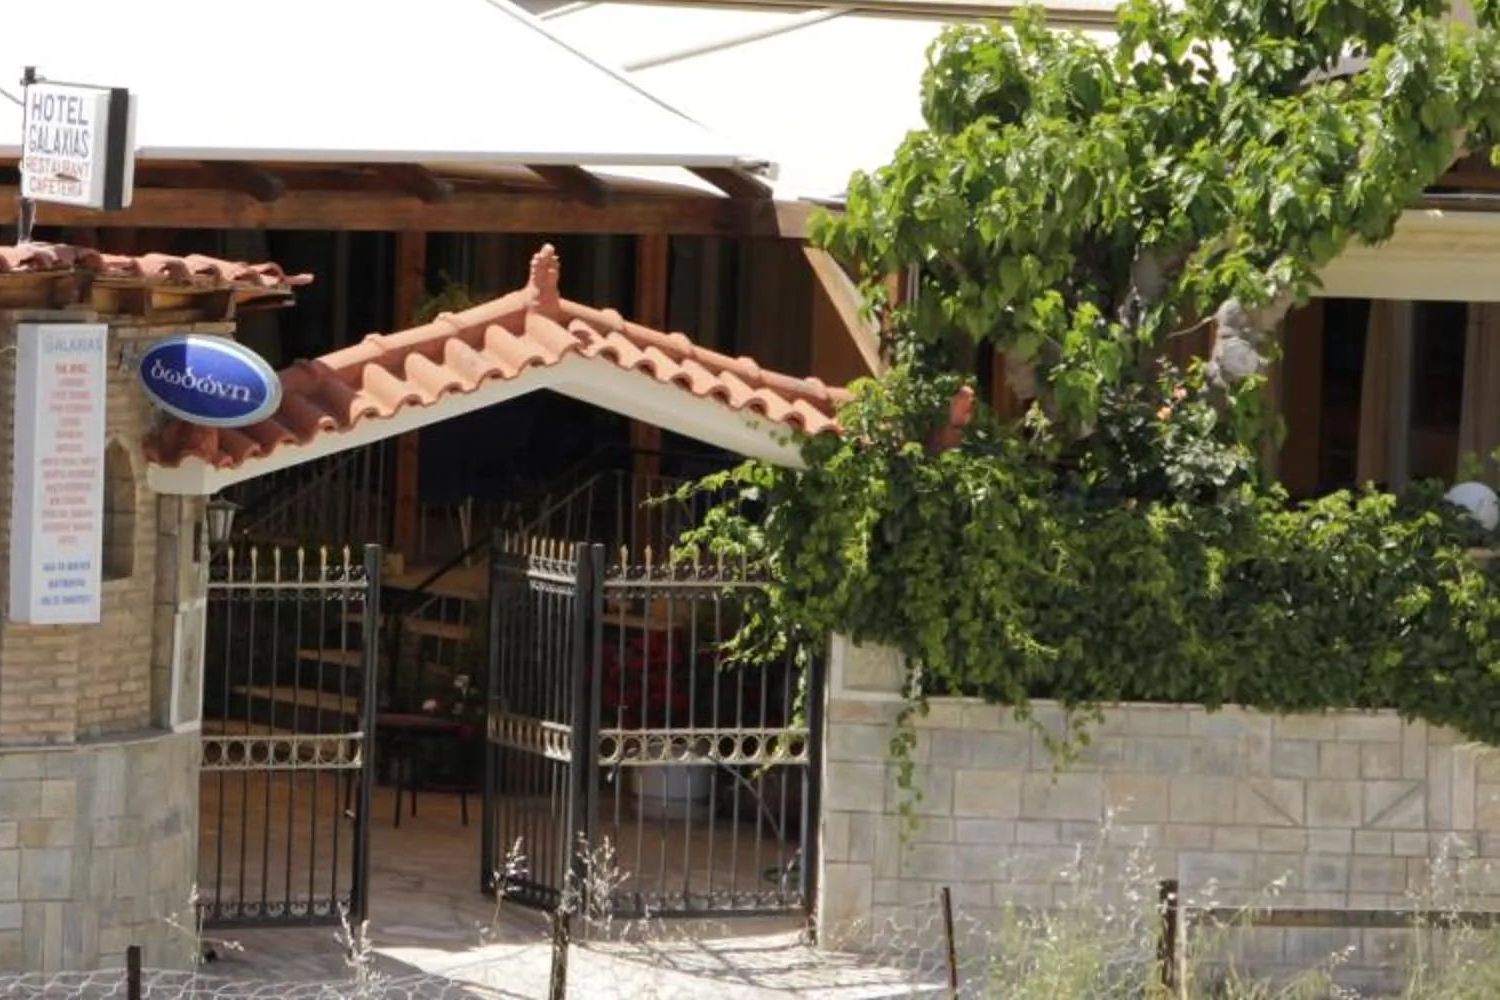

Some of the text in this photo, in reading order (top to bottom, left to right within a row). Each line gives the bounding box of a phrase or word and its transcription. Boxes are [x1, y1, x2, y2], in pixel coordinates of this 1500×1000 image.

[31, 92, 89, 126] HOTEL
[28, 124, 90, 158] GALAXIAS
[150, 358, 251, 402] δωδώνη
